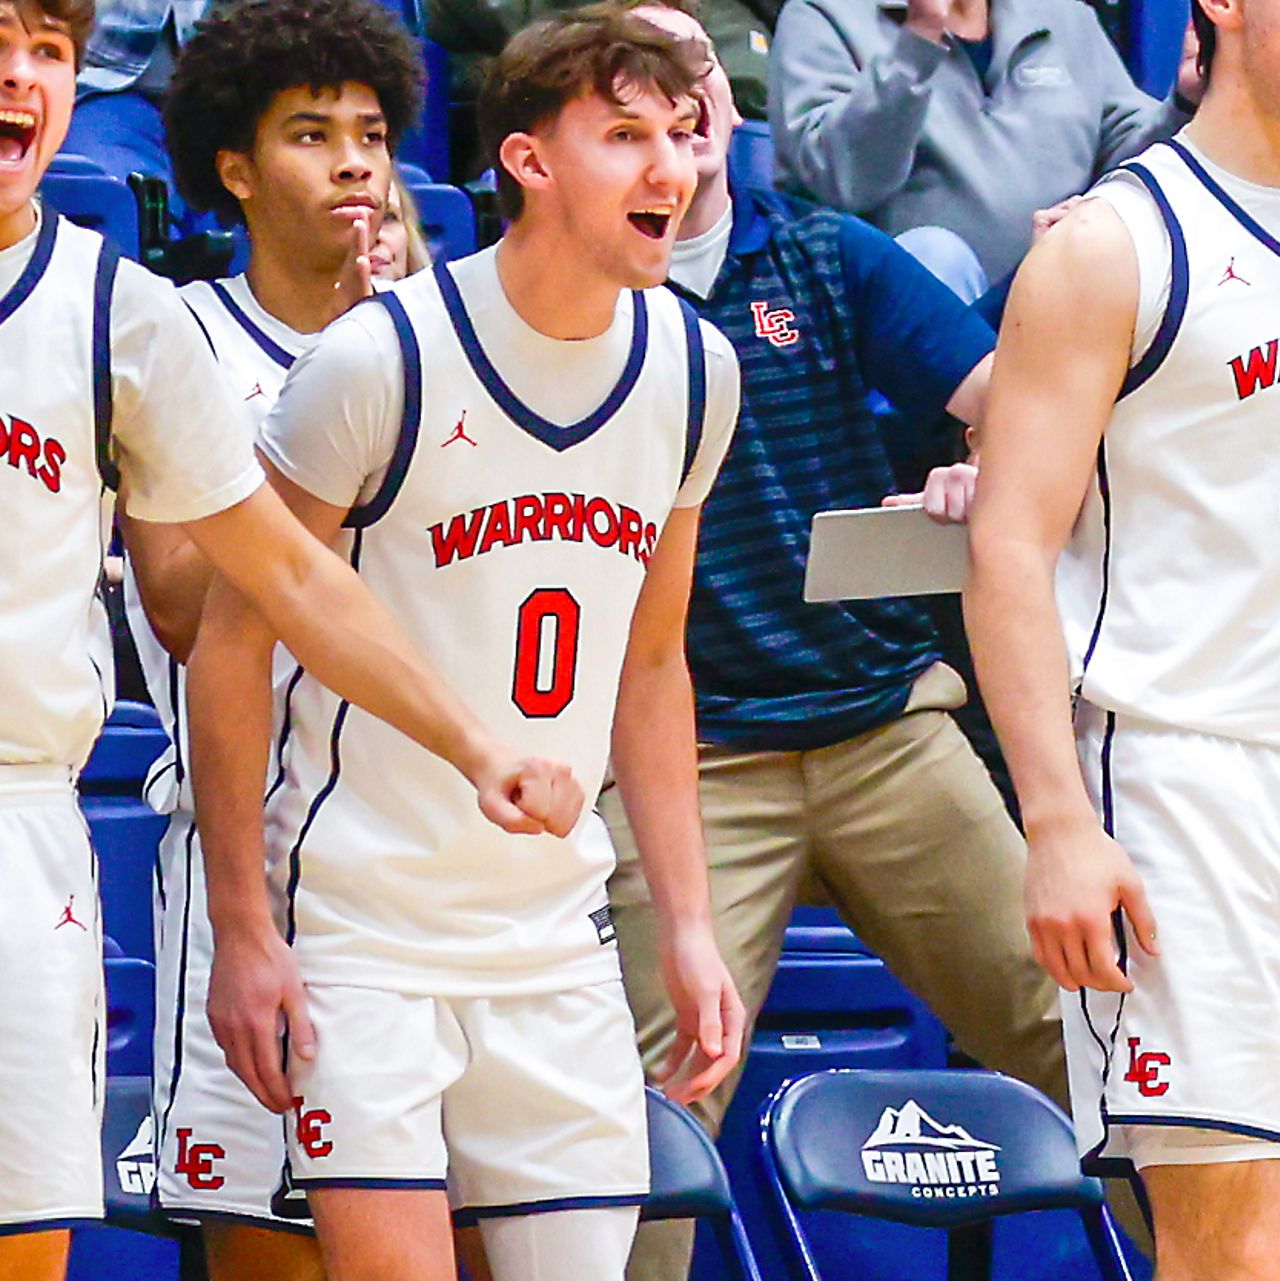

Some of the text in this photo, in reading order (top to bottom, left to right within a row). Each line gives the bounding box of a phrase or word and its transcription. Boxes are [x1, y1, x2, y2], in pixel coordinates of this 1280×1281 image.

[750, 301, 799, 347] LC
[511, 587, 582, 719] 0
[1125, 1037, 1172, 1097] LC
[174, 1128, 225, 1190] LC
[860, 1150, 1000, 1185] GRANITE
[911, 1183, 999, 1198] CONCEPTS
